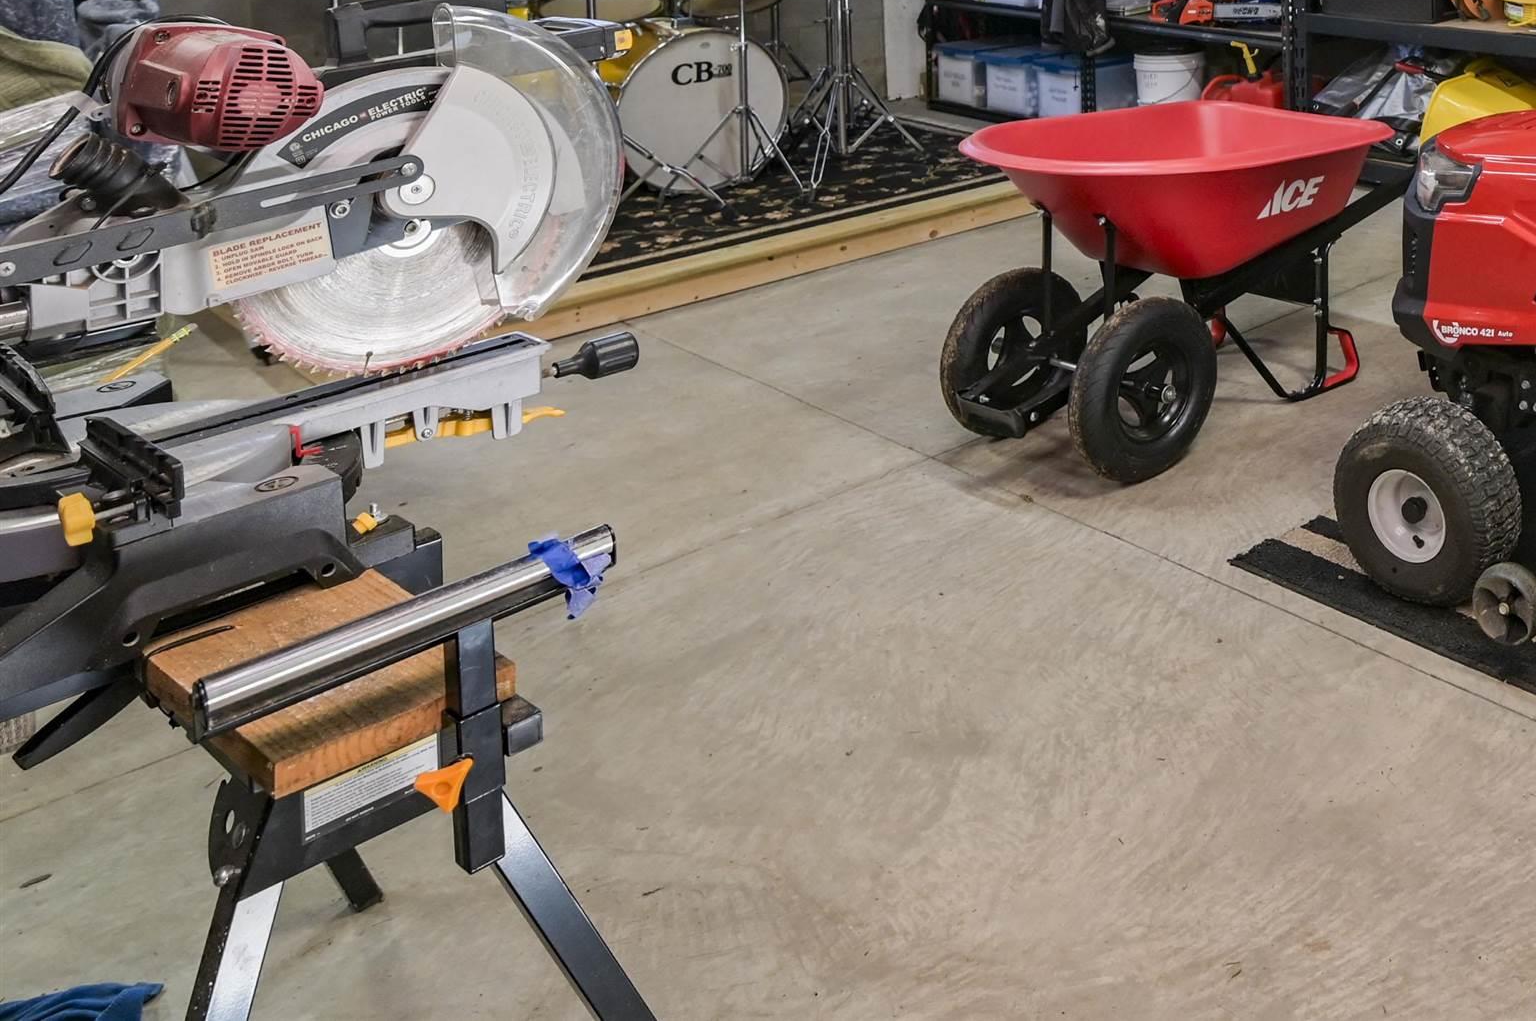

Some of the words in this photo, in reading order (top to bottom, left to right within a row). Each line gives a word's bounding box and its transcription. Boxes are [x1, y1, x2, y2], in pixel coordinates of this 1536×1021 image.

[367, 88, 426, 117] ELECTRIC
[370, 106, 399, 121] POWER
[400, 95, 426, 109] TOOLS
[302, 114, 359, 143] CHICAGO
[1256, 175, 1326, 220] ACE
[212, 242, 246, 257] BLADE
[249, 222, 322, 246] REPLACEMENT
[222, 258, 241, 268] HOLD
[250, 248, 277, 260] SPINDLE
[277, 243, 294, 252] LOCK
[306, 235, 323, 244] BACK
[221, 250, 249, 261] UNPLUG
[223, 265, 242, 274] OPEN
[243, 254, 273, 268] MOVABLE
[275, 249, 298, 258] GUARD
[224, 268, 252, 279] REMOVE
[253, 261, 276, 272] ARBOR
[295, 251, 314, 259] TURN
[225, 272, 263, 285] CLOCKWISE
[268, 261, 297, 273] REVERSE
[1441, 325, 1479, 336] BRONCO
[1497, 330, 1513, 338] Auto
